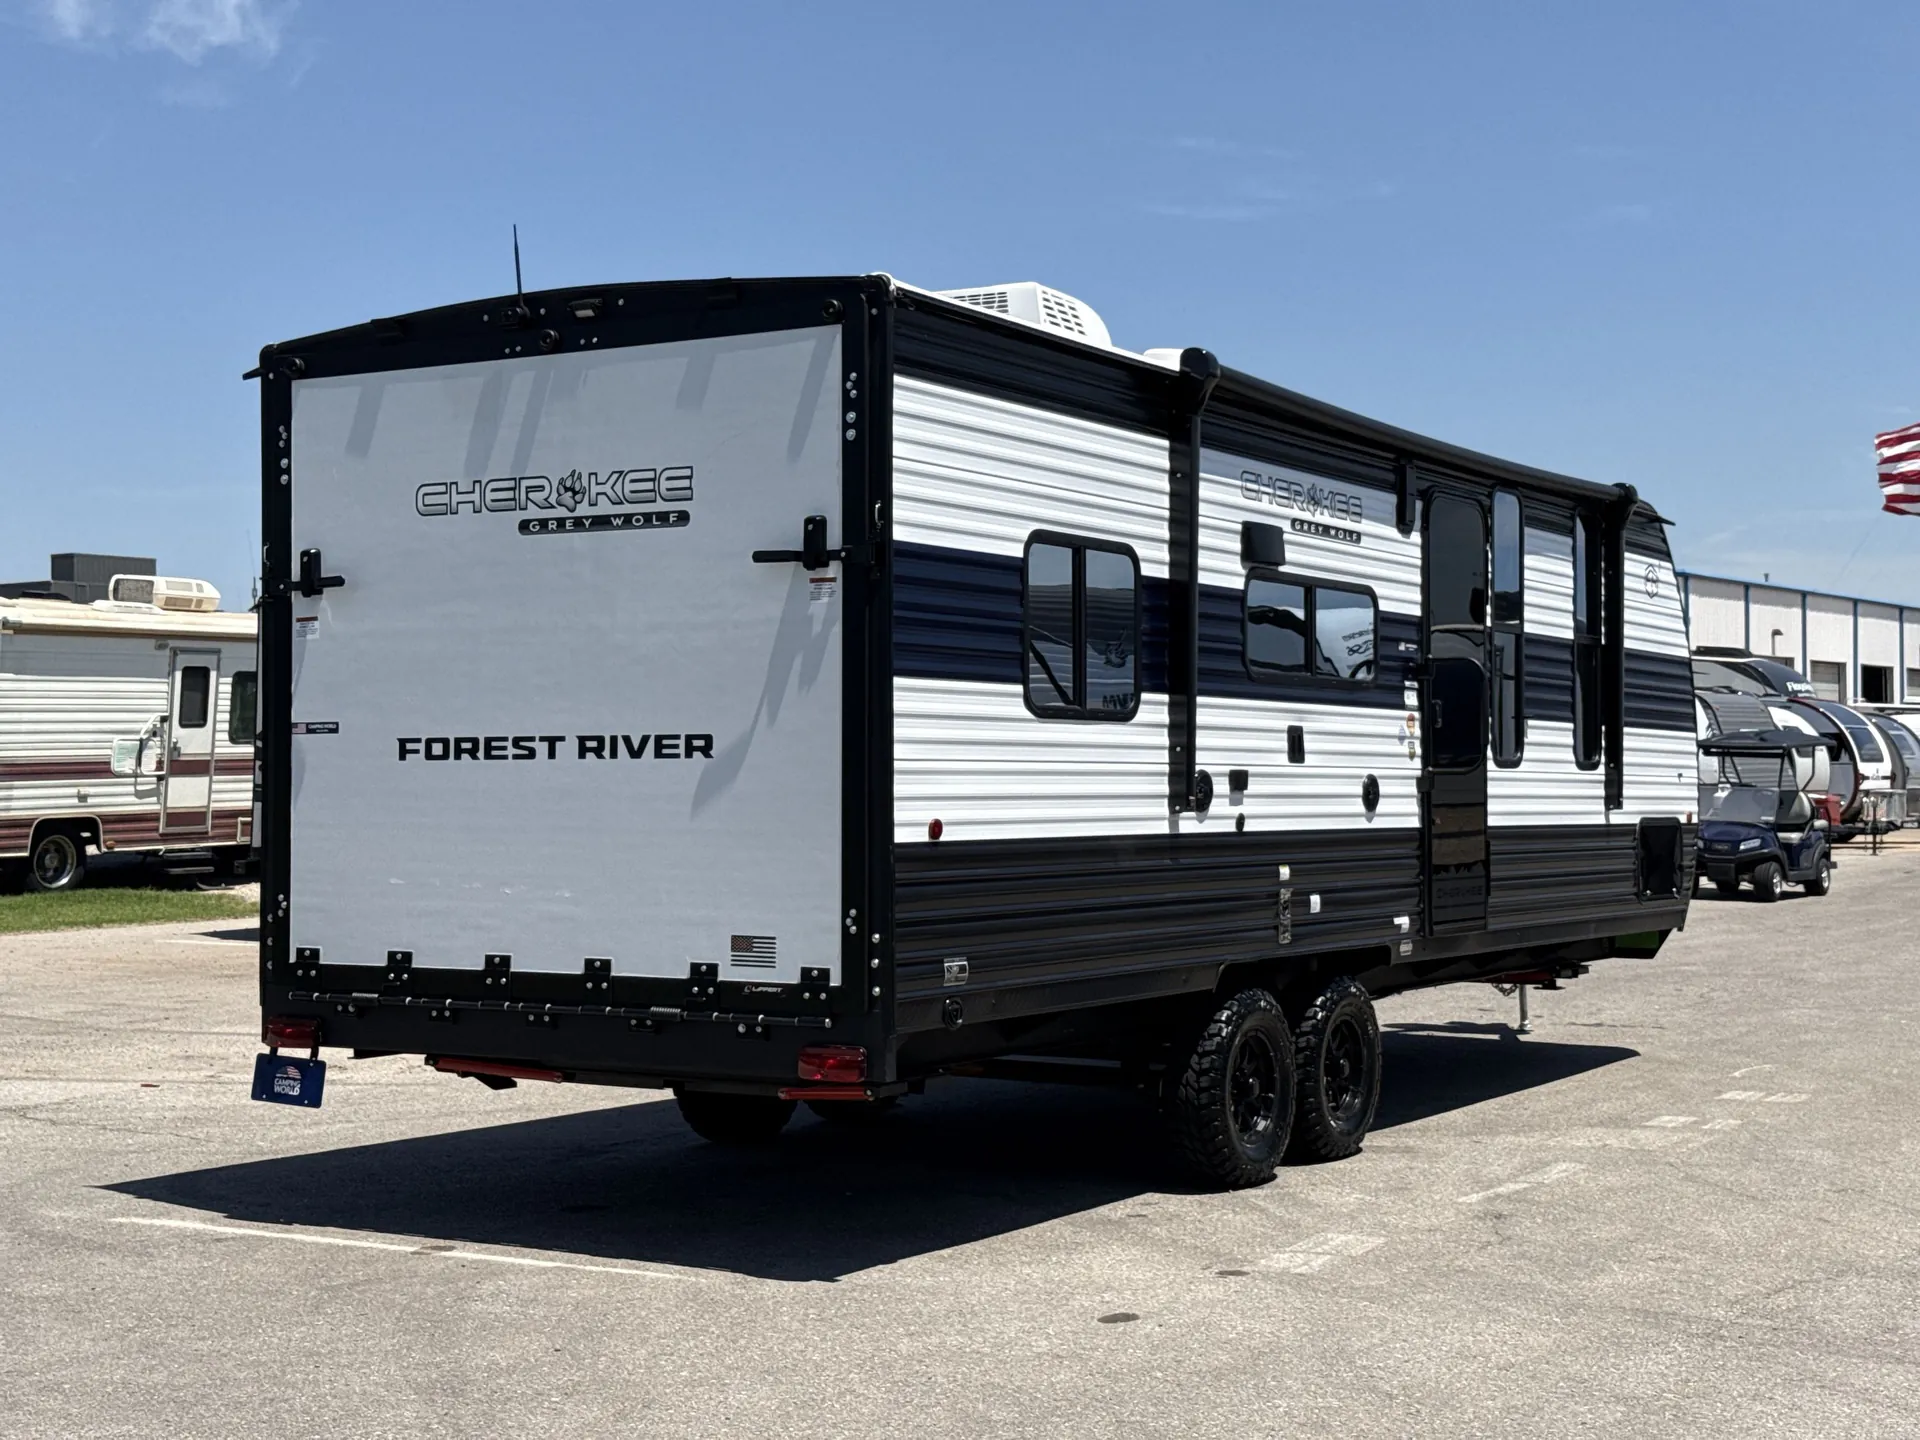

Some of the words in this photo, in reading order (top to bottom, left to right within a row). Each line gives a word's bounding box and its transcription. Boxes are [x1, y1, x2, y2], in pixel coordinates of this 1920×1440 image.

[529, 517, 593, 533] GREY
[611, 513, 680, 528] WOLF
[1294, 520, 1324, 534] GREY
[1329, 529, 1358, 542] WOLF
[397, 736, 566, 761] FOREST
[575, 733, 715, 760] RIVER
[274, 1078, 301, 1088] CAMPING
[274, 1084, 300, 1095] WORLD
